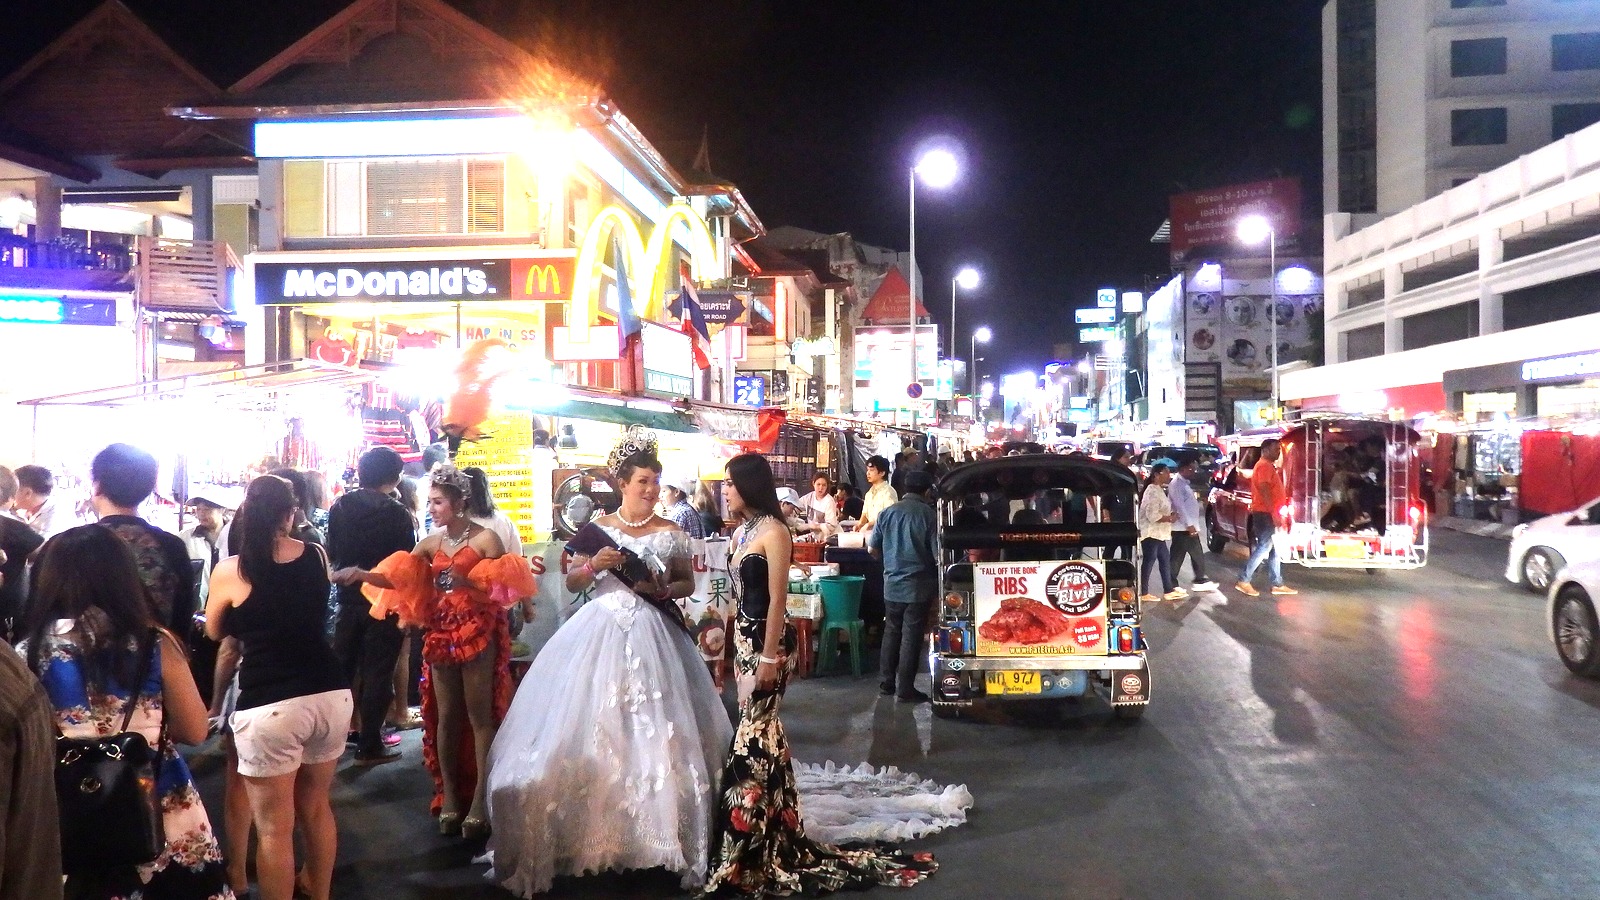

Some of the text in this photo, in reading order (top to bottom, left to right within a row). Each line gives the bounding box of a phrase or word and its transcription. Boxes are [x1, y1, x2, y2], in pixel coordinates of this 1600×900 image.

[710, 313, 727, 321] ROAD
[737, 388, 761, 406] 24
[808, 395, 820, 404] 24
[998, 566, 1008, 575] OFF
[1010, 566, 1022, 575] THE
[1051, 565, 1098, 582] Restaurant
[993, 576, 1028, 595] RIBS
[1060, 571, 1088, 588] Fat
[1055, 586, 1097, 605] Elvis
[1059, 603, 1091, 613] and Bar
[1013, 671, 1035, 685] 977
